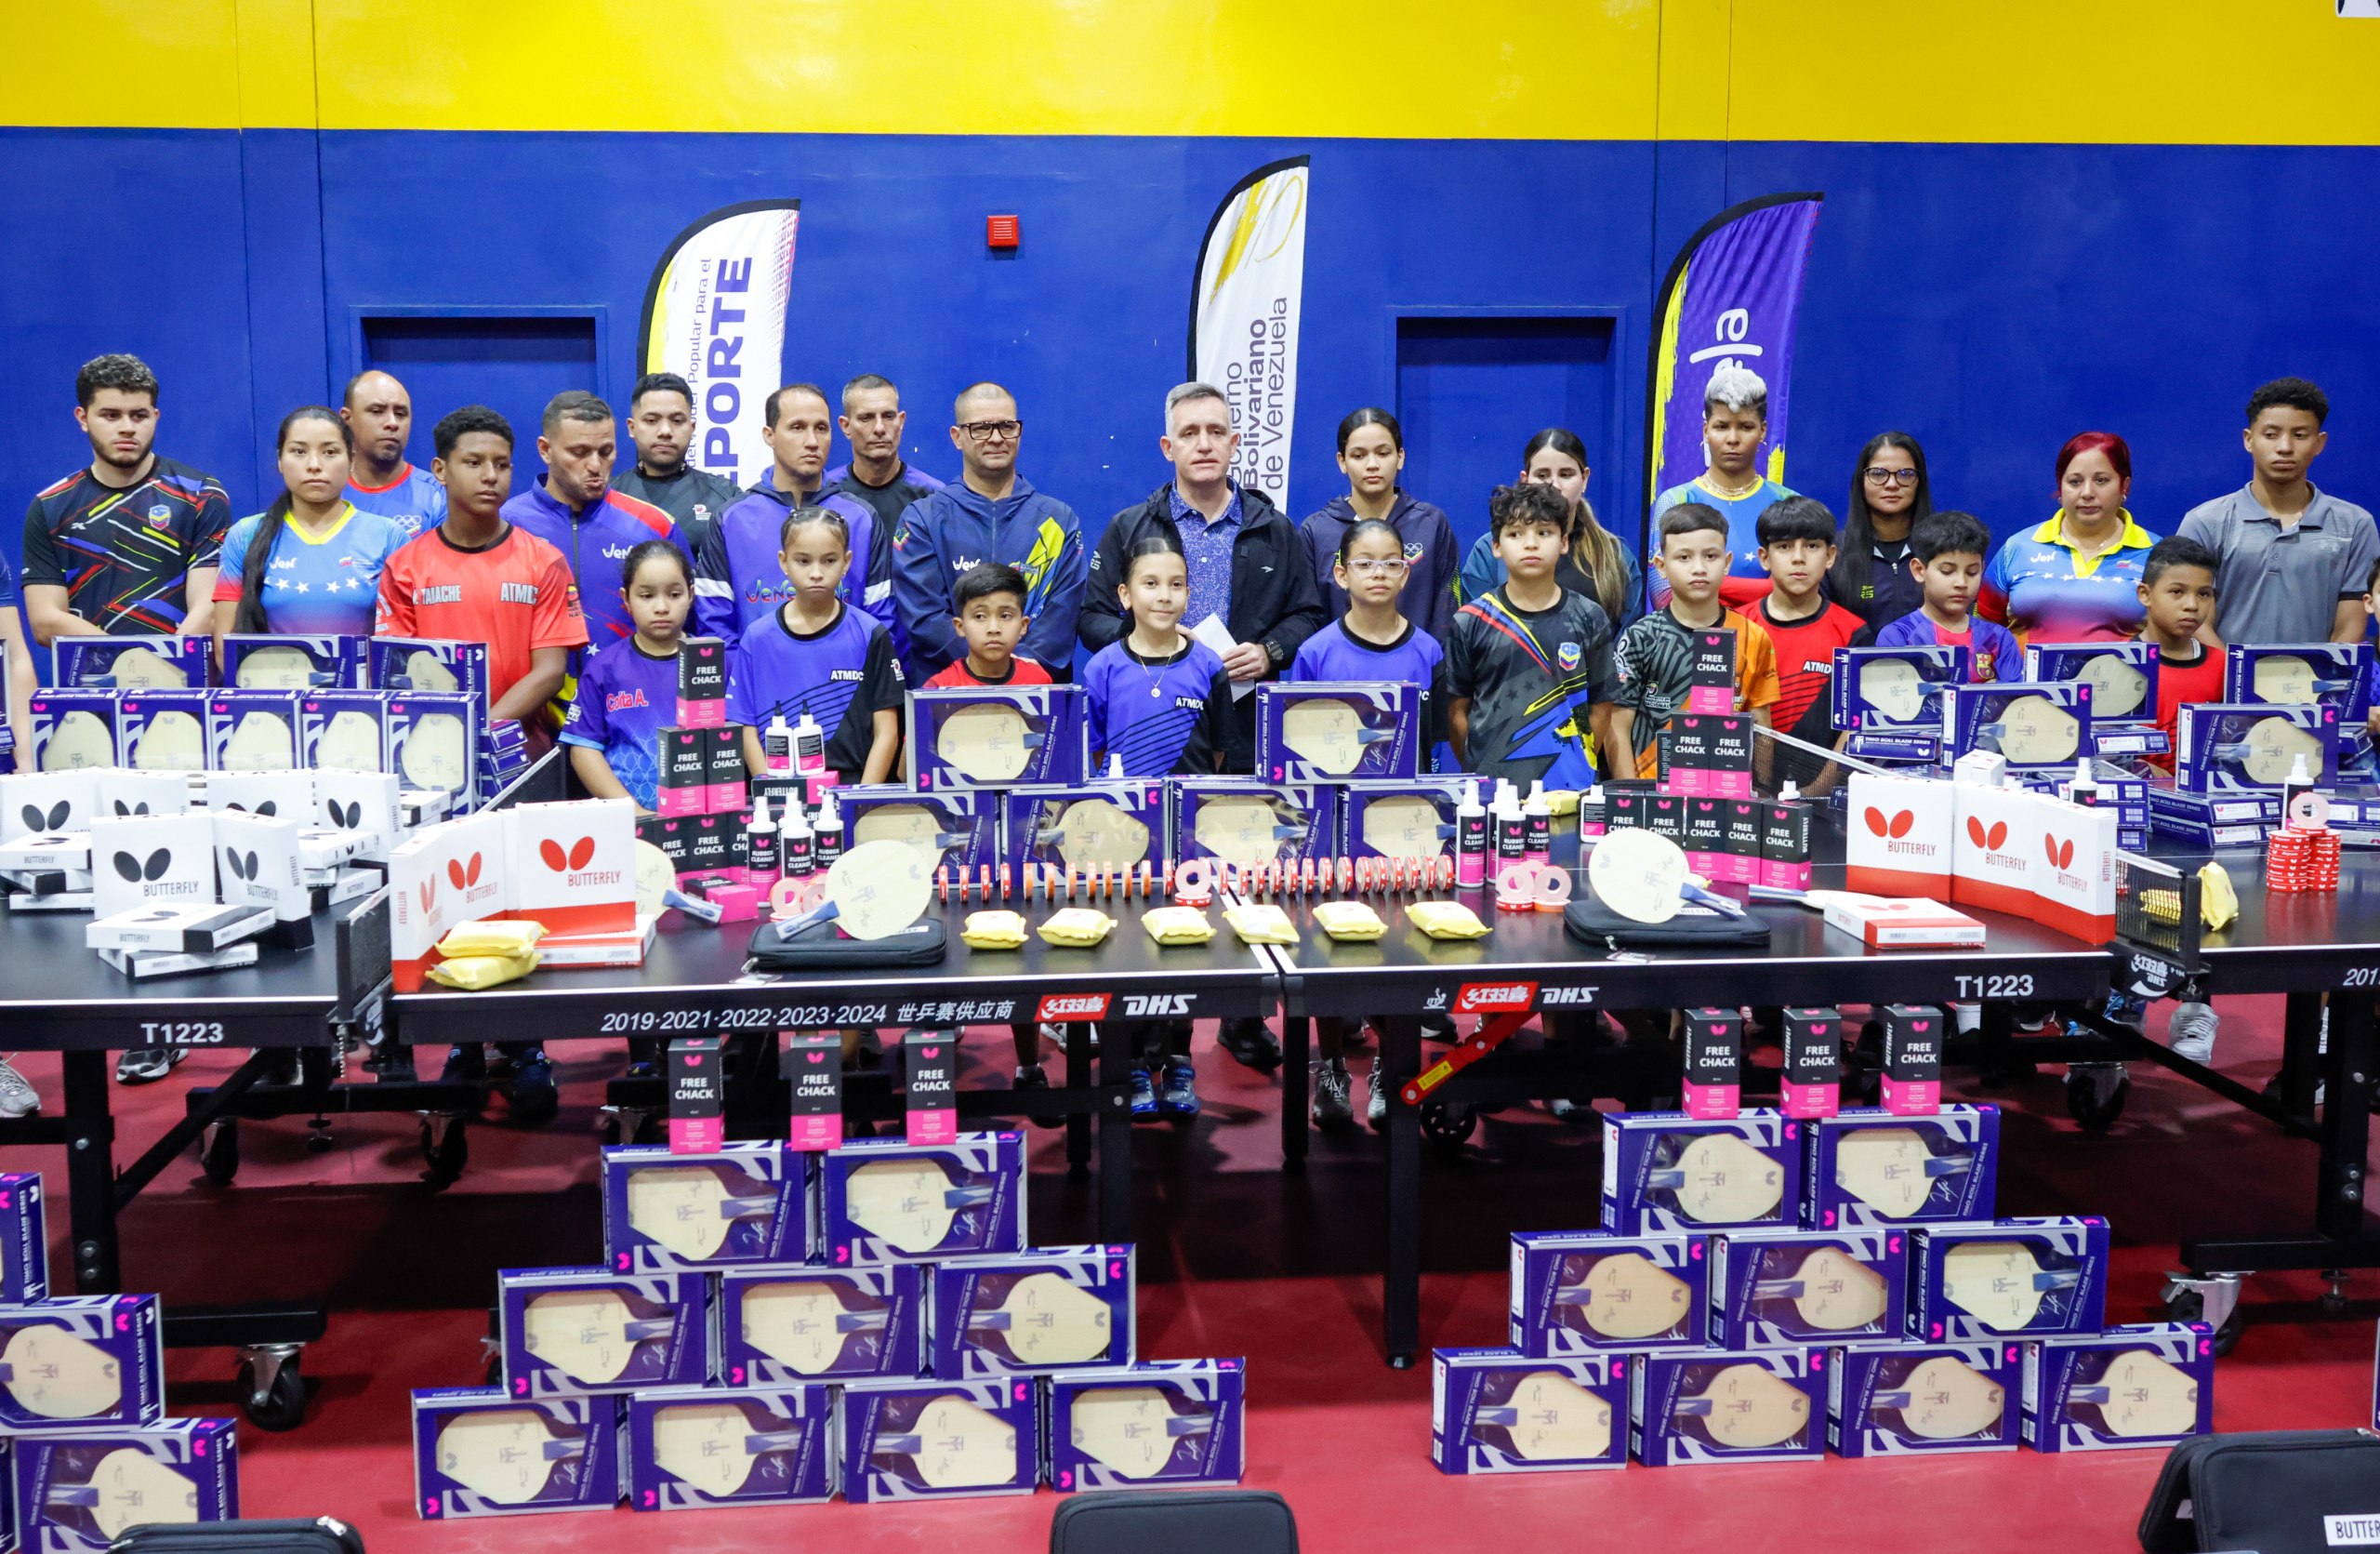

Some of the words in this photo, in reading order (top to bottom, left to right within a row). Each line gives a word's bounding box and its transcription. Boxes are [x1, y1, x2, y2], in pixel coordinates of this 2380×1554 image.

[701, 259, 711, 272] el
[695, 292, 707, 314] para
[688, 320, 703, 383] Popular
[1262, 298, 1287, 446] Venezuela
[1243, 320, 1266, 489] Bolivariano
[1261, 456, 1283, 489] de
[695, 666, 717, 675] FREE
[1697, 663, 1727, 672] CHACK
[692, 675, 721, 684] CHACK
[1680, 737, 1701, 745] FREE
[1720, 738, 1740, 747] FREE
[717, 750, 736, 759] FREE
[1675, 745, 1705, 754] CHACK
[1714, 747, 1745, 757] CHACK
[678, 753, 697, 763] FREE
[712, 758, 742, 769] CHACK
[673, 763, 702, 772] CHACK
[1613, 817, 1634, 825] FREE
[1733, 823, 1752, 831] FREE
[1770, 828, 1790, 837] FREE
[1690, 829, 1721, 837] CHACK
[1728, 831, 1757, 842] CHACK
[662, 839, 682, 849] FREE
[698, 835, 720, 845] FREE
[1766, 837, 1793, 848] CHACK
[694, 844, 724, 856] CHACK
[1887, 841, 1937, 856] BUTTERFLY
[1986, 852, 2027, 870] BUTTERFLY
[568, 870, 621, 886] BUTTERFLY
[2057, 871, 2088, 893] BUTTERFLY
[143, 881, 199, 897] BUTTERFLY
[246, 883, 278, 900] BUTTERFLY
[466, 882, 498, 903] BUTTERFLY
[2343, 968, 2380, 986] 201
[1955, 975, 2034, 997] T1223
[1461, 986, 1528, 1009] 红双喜
[1541, 987, 1599, 1003] DHS
[1039, 997, 1106, 1017] 红双喜
[1122, 994, 1197, 1016] DHS
[897, 1001, 1015, 1021] 世乒赛供应商
[141, 1023, 223, 1043] T1223
[1705, 1045, 1730, 1056] FREE
[1805, 1045, 1830, 1056] FREE
[1907, 1043, 1932, 1053] FREE
[1699, 1056, 1735, 1067] CHACK
[1800, 1056, 1835, 1067] CHACK
[1900, 1054, 1937, 1064] CHACK
[802, 1074, 829, 1085] FREE
[917, 1069, 945, 1080] FREE
[681, 1077, 707, 1088] FREE
[912, 1081, 950, 1092] CHACK
[675, 1088, 714, 1099] CHACK
[797, 1085, 835, 1096] CHACK
